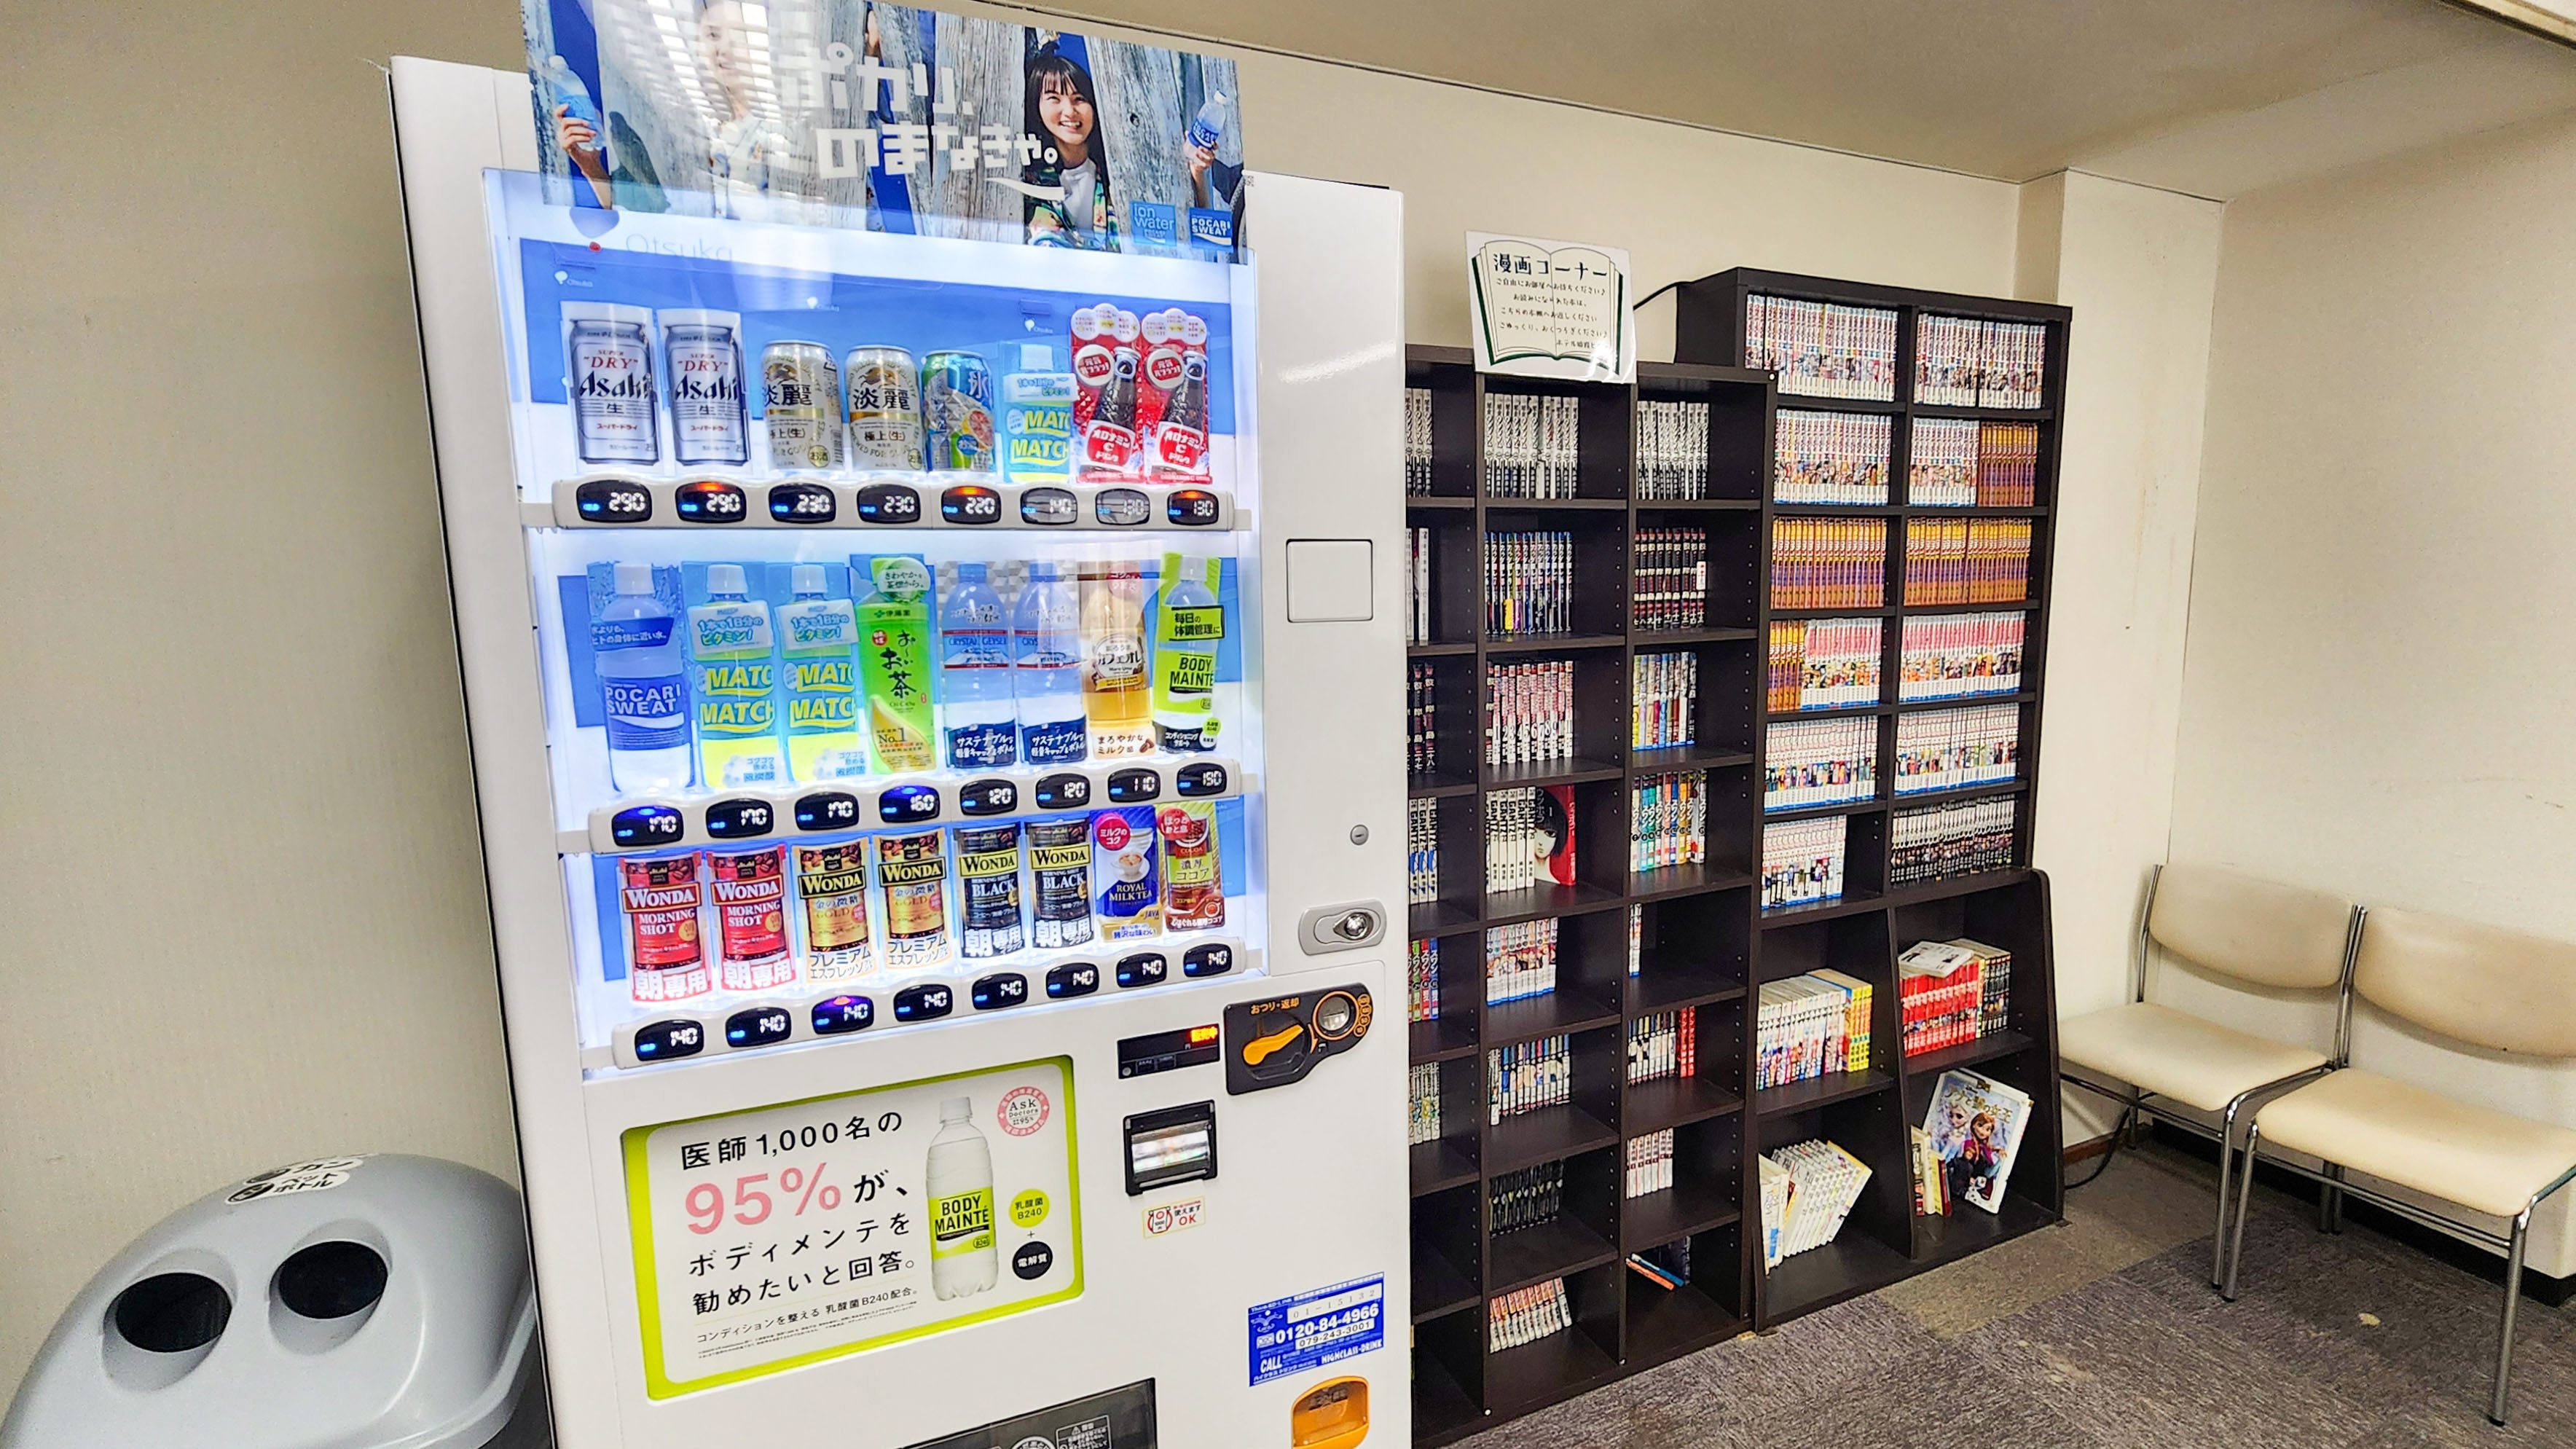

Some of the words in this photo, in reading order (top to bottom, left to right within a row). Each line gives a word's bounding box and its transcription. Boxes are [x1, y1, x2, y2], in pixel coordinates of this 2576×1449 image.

[816, 120, 1059, 179] のまなきゃ。
[1134, 205, 1155, 218] ion
[1134, 216, 1175, 230] water
[1191, 217, 1231, 229] POCARI
[1191, 225, 1228, 236] SWEAT
[1493, 253, 1608, 280] 漫画コーナー
[579, 370, 652, 400] Asahi
[675, 374, 738, 401] Asahi
[762, 383, 813, 407] 淡麗
[853, 388, 910, 410] 淡麗
[609, 492, 645, 512] 290
[706, 493, 741, 514] 290
[797, 494, 830, 514] 230
[884, 495, 915, 514] 230
[965, 497, 996, 514] 220
[1193, 500, 1214, 517] 130
[1174, 613, 1201, 624] 毎日の
[1174, 624, 1220, 637] 体調管理に
[1179, 656, 1212, 672] BODY
[605, 683, 681, 702] POCARI
[605, 699, 677, 715] SWEAT
[1064, 782, 1085, 799] 120
[1134, 777, 1155, 793] 110
[910, 794, 935, 812] 160
[989, 788, 1012, 805] 120
[740, 808, 767, 827] 170
[827, 801, 853, 820] 170
[648, 815, 678, 834] 170
[1100, 828, 1128, 838] ミルクの
[1106, 837, 1121, 846] コク
[963, 855, 1015, 873] WONDA
[1034, 849, 1086, 865] WONDA
[882, 862, 941, 882] WONDA
[1042, 871, 1085, 890] BLACK
[1177, 868, 1209, 881] ココア
[714, 881, 779, 903] WONDA
[802, 873, 863, 895] WONDA
[972, 879, 1014, 898] BLACK
[1116, 882, 1147, 893] ROYAL
[625, 888, 694, 909] WONDA
[1109, 892, 1136, 902] MILK
[1136, 890, 1152, 900] TEA
[638, 908, 695, 924] MORNING
[727, 900, 781, 917] MORNING
[640, 922, 675, 935] SHOT
[729, 914, 763, 927] SHOT
[965, 925, 1021, 957] 朝専用
[1034, 918, 1091, 947] 朝専用
[887, 933, 947, 954] プレミアム
[809, 946, 871, 967] プレミアム
[1207, 950, 1227, 965] 140
[723, 958, 793, 990] 朝専用
[1142, 959, 1163, 975] 140
[634, 968, 707, 1000] 朝専用
[1072, 970, 1093, 986] 140
[1000, 981, 1022, 997] 140
[924, 991, 947, 1009] 140
[1250, 997, 1300, 1016] おつり・返却
[843, 1002, 868, 1021] 140
[760, 1014, 786, 1034] 140
[669, 1027, 699, 1047] 140
[1008, 1107, 1038, 1118] Doctors
[1009, 1098, 1037, 1112] Ask
[680, 1111, 903, 1171] 医師1,000名の
[273, 1181, 334, 1193] ボトル
[941, 1194, 981, 1216] BODY
[1015, 1197, 1043, 1210] 乳酸菌
[935, 1205, 989, 1233] MAINTÉ
[1017, 1207, 1042, 1220] B240
[1179, 1213, 1196, 1226] OK
[688, 1212, 911, 1277] ボディメンテを
[1017, 1252, 1048, 1268] 電解質
[692, 1249, 915, 1316] 勧めたいと回答。
[697, 1308, 820, 1343] コンディションを整える
[825, 1287, 918, 1313] 乳酸菌B240配合。
[1276, 1303, 1379, 1344] 0120-84-4966
[1299, 1321, 1370, 1347] 079-243-3001
[1260, 1354, 1283, 1373] CALL
